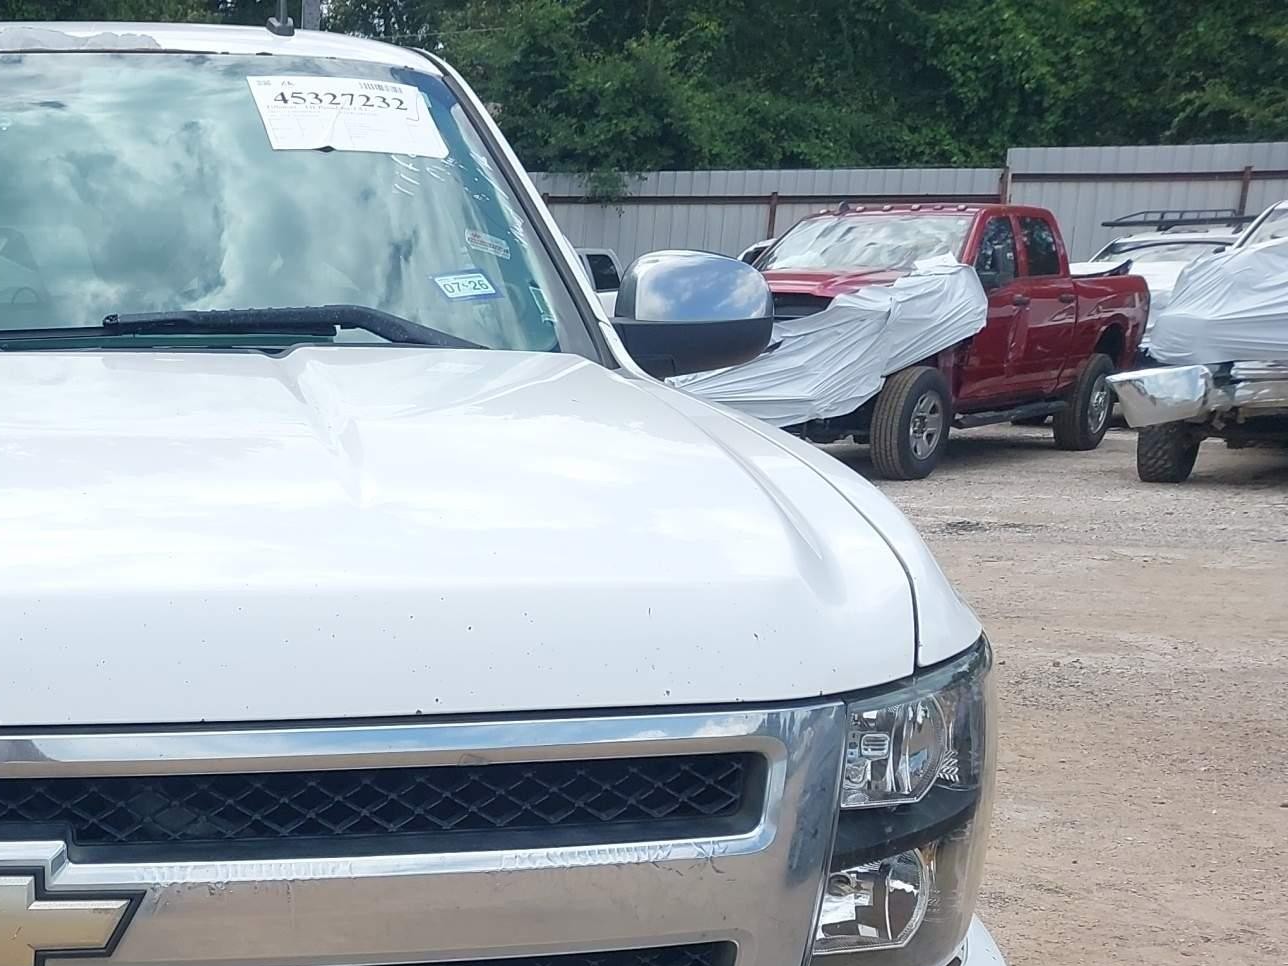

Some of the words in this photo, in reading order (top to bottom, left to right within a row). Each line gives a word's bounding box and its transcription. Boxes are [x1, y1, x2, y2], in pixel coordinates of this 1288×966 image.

[274, 91, 408, 111] 45327232
[443, 282, 462, 294] 07
[469, 280, 489, 290] 26
